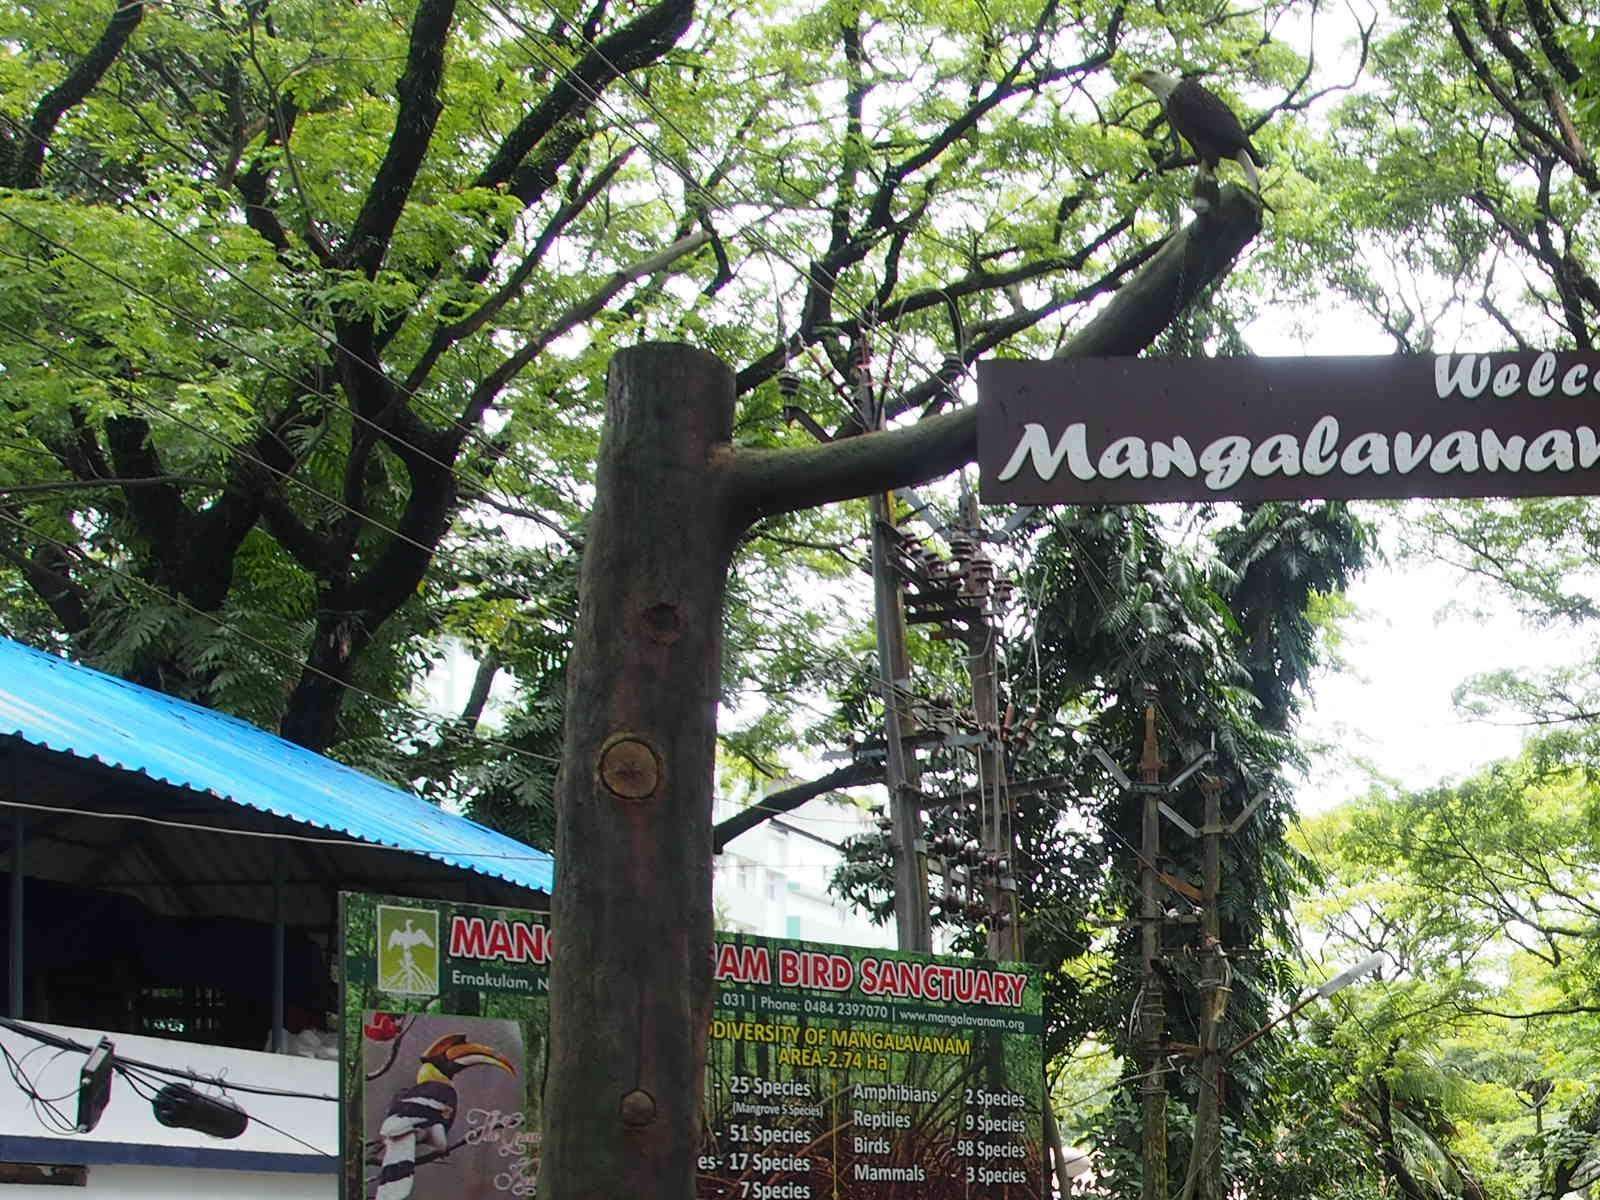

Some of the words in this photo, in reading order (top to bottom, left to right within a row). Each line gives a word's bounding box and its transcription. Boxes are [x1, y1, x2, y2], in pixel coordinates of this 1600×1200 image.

[452, 970, 533, 991] Ernakulam,
[713, 943, 771, 984] AM
[779, 950, 853, 991] BIRD
[860, 958, 1027, 1007] SANCTUARY
[723, 993, 745, 1007] 031
[761, 996, 800, 1012] Phone:
[804, 1000, 834, 1014] 0484
[837, 1002, 887, 1018] 2397070
[899, 1011, 1024, 1032] www.mangalavanam.org
[708, 1020, 800, 1045] DIVERSITY
[805, 1027, 827, 1045] OF
[831, 1030, 970, 1055] MANGALAVANAM
[778, 1048, 861, 1068] AREA-2.74
[867, 1053, 887, 1070] Ha
[730, 1076, 749, 1094] 25
[753, 1077, 810, 1098] Species
[853, 1083, 937, 1103] Amphibians
[965, 1088, 973, 1104] 2
[977, 1089, 1025, 1109] Species
[733, 1102, 779, 1116] (Mangrove
[854, 1110, 911, 1130] Reptiles
[966, 1114, 973, 1130] 9
[977, 1115, 1025, 1134] Species
[729, 1124, 749, 1142] 51
[753, 1125, 811, 1146] Species
[854, 1137, 890, 1154] Birds
[977, 1141, 1026, 1160] Species
[697, 1154, 723, 1170] es-
[729, 1153, 748, 1171] 17
[753, 1154, 810, 1175] Species
[854, 1164, 925, 1182] Mammals
[967, 1166, 974, 1182] 3
[978, 1167, 1026, 1186] Species
[741, 1182, 749, 1199] 7
